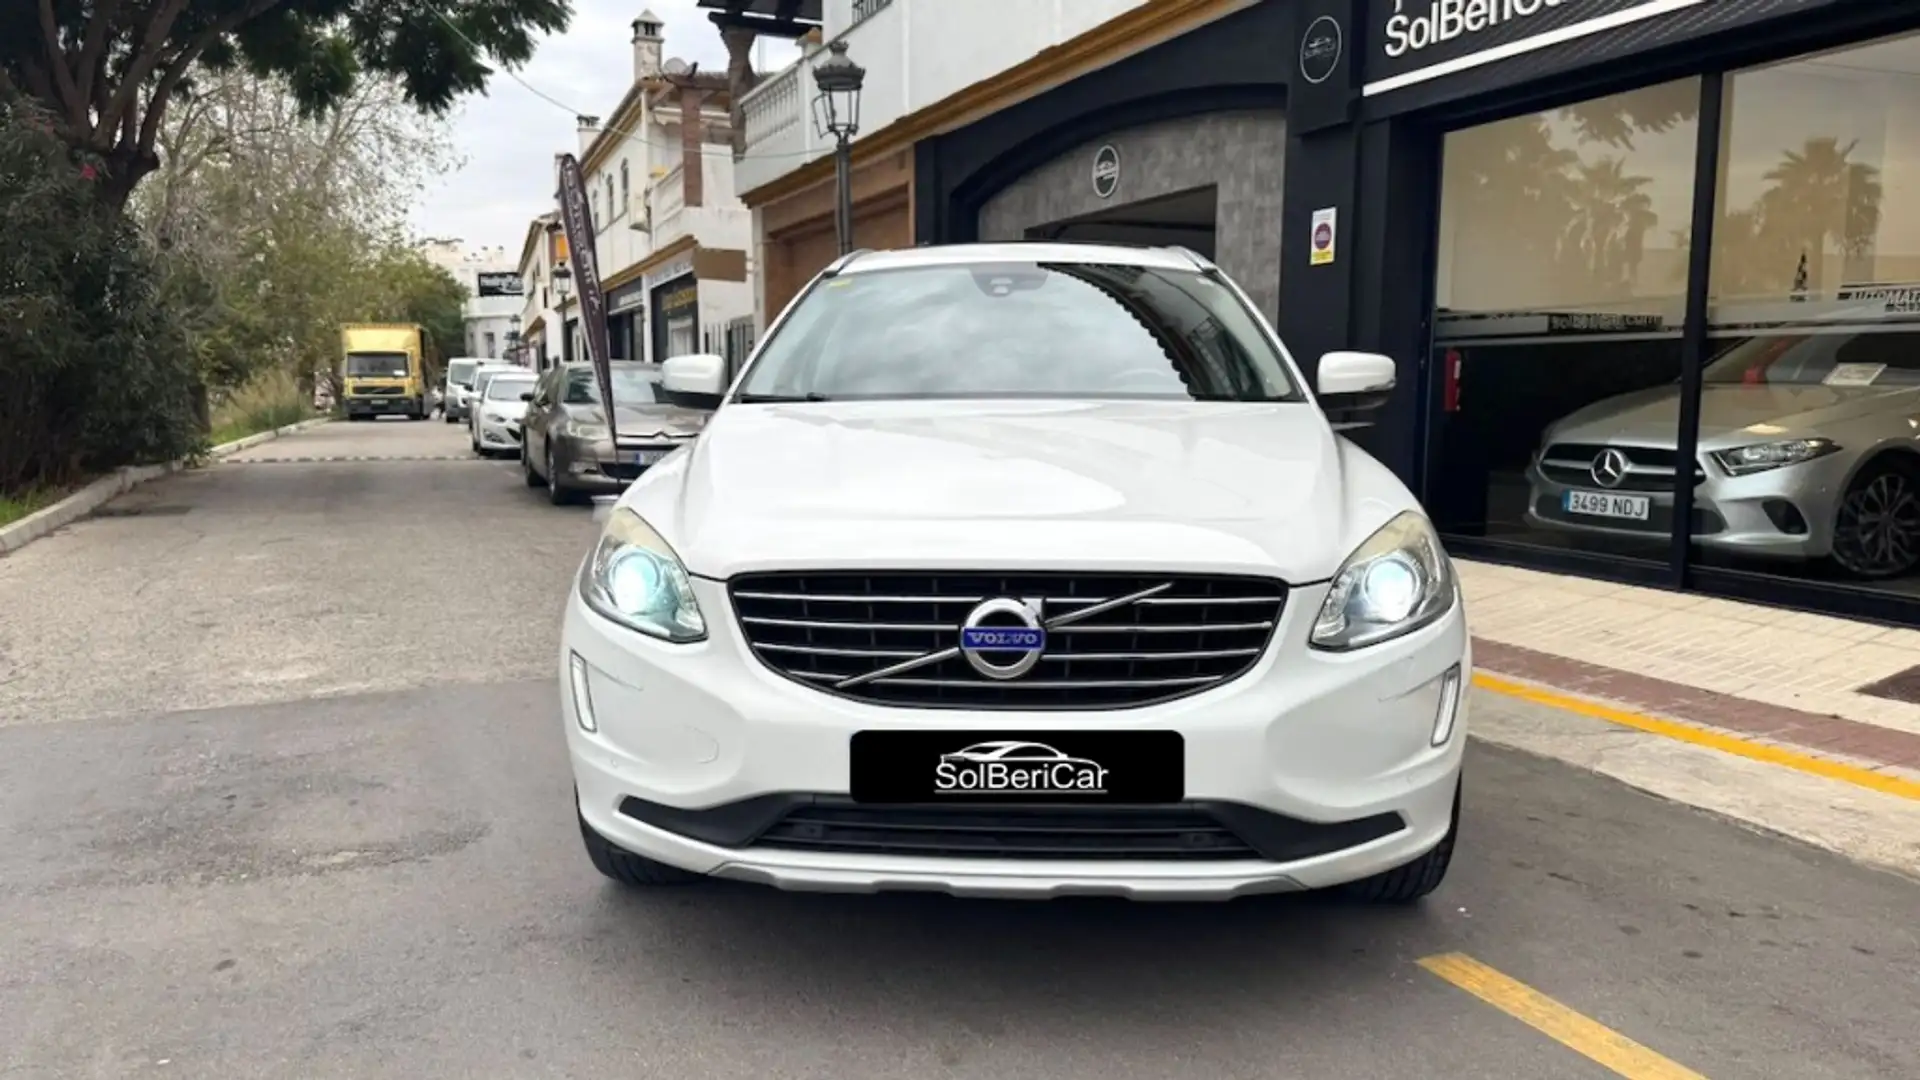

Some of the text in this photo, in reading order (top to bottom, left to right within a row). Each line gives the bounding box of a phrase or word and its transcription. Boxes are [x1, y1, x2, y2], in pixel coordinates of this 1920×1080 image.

[1571, 494, 1645, 517] 3499 NDJ
[967, 632, 1037, 645] VOLVO
